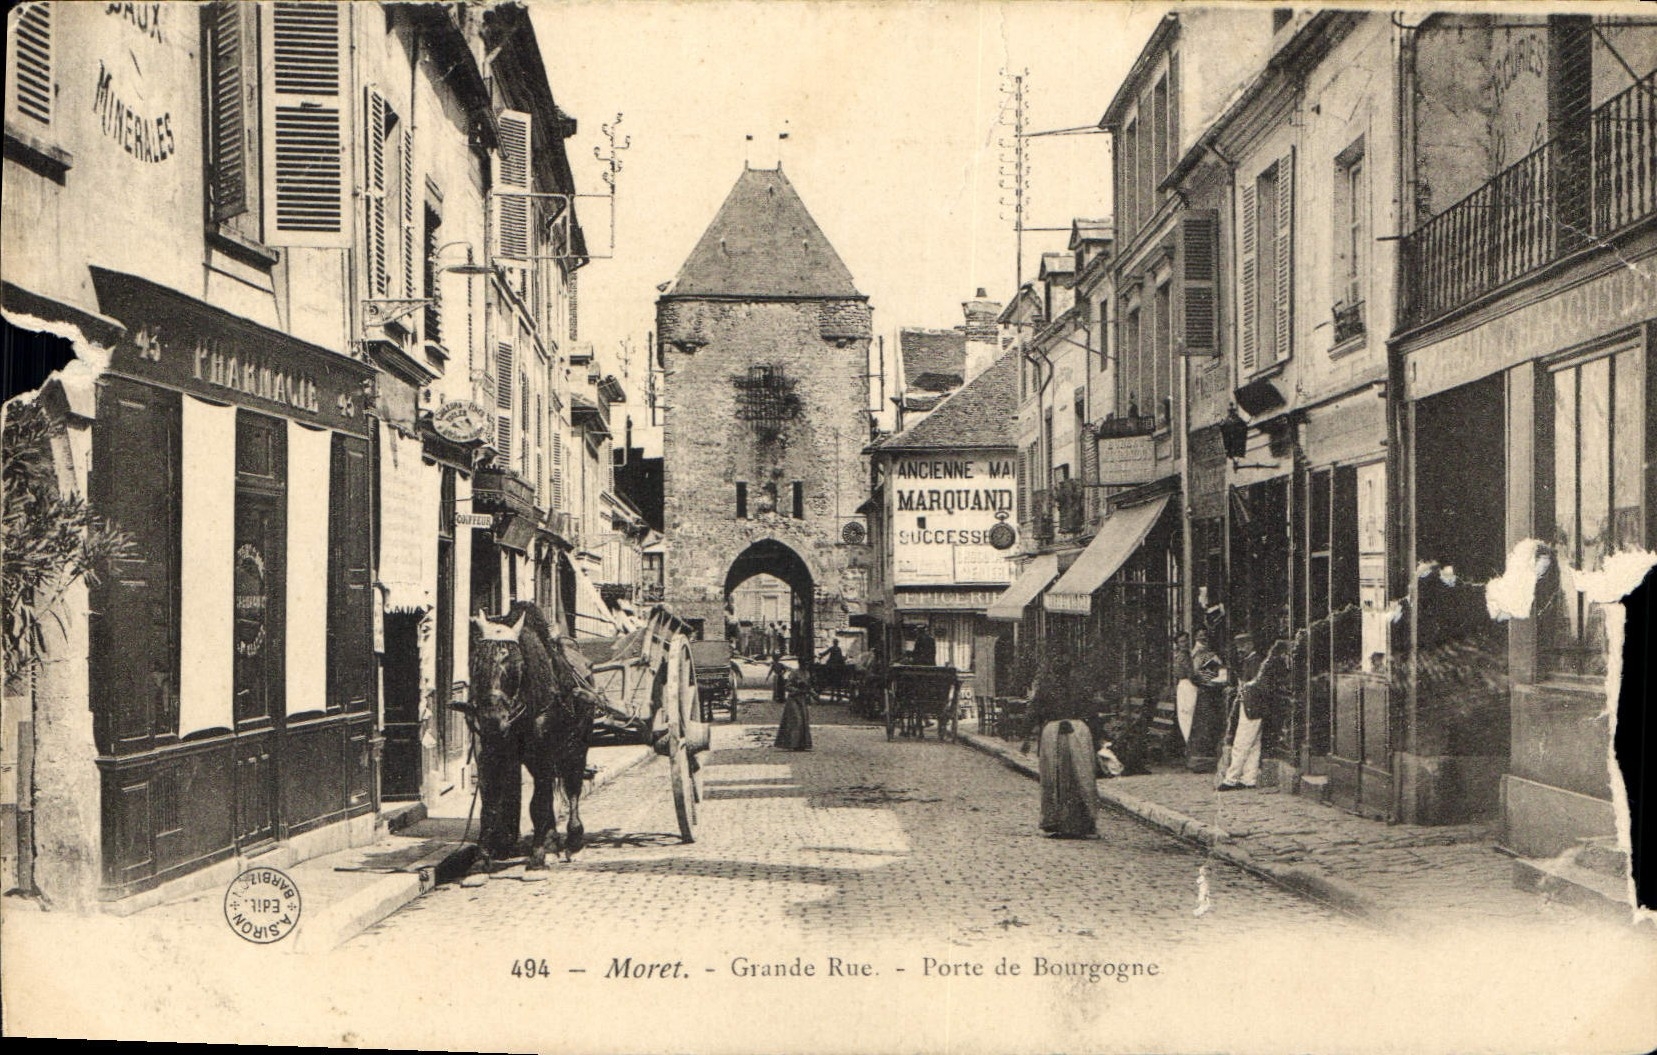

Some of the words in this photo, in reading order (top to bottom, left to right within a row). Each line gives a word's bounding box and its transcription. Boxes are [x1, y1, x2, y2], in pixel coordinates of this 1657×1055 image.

[193, 344, 319, 413] PHARMACIE
[898, 461, 974, 479] ANCIENNE
[897, 489, 1013, 515] MARQUAND
[456, 514, 492, 528] COIFFEUR
